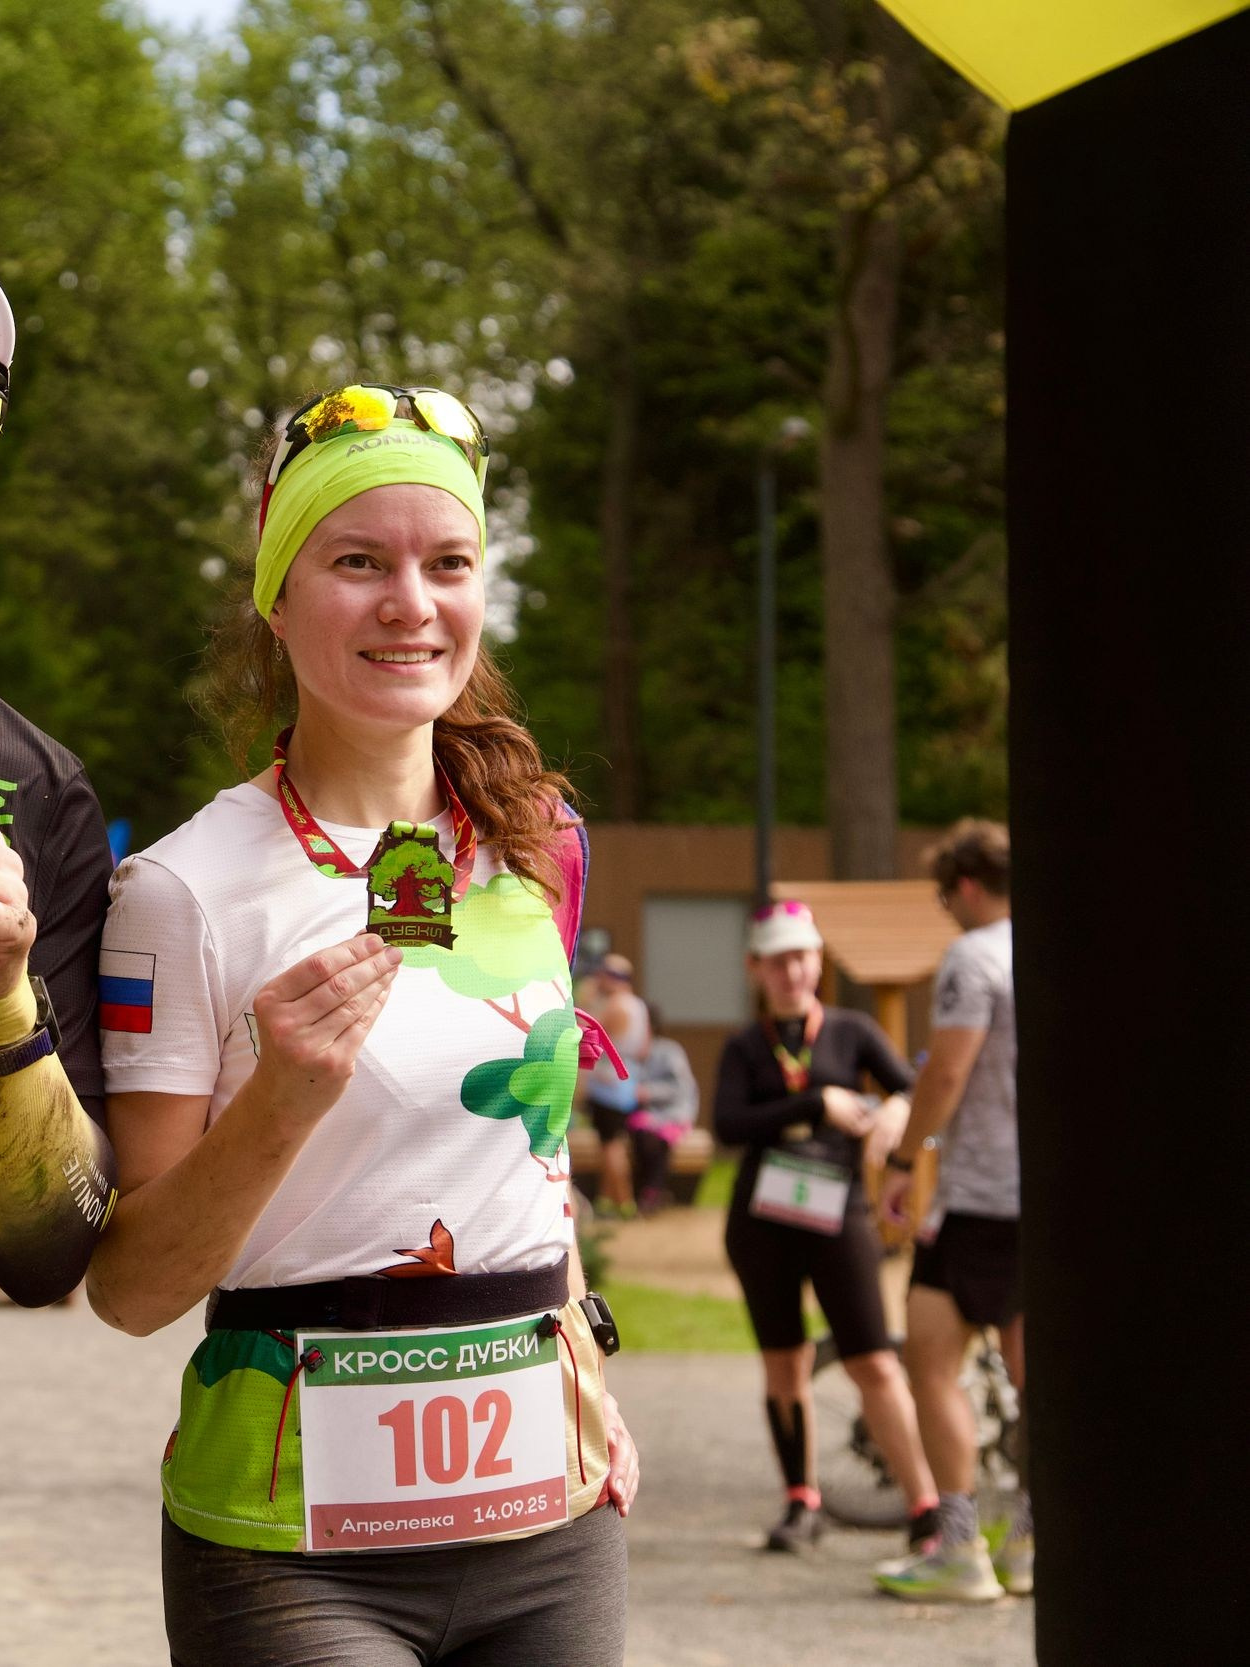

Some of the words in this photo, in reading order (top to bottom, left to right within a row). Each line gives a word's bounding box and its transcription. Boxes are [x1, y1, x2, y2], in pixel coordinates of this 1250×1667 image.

[379, 925, 443, 938] ДУБКИ
[334, 1347, 448, 1375] КРОСС
[456, 1332, 539, 1372] ДУБКИ
[378, 1389, 513, 1487] 102
[340, 1513, 455, 1534] Апрелевка
[473, 1494, 548, 1524] 14.09.25
